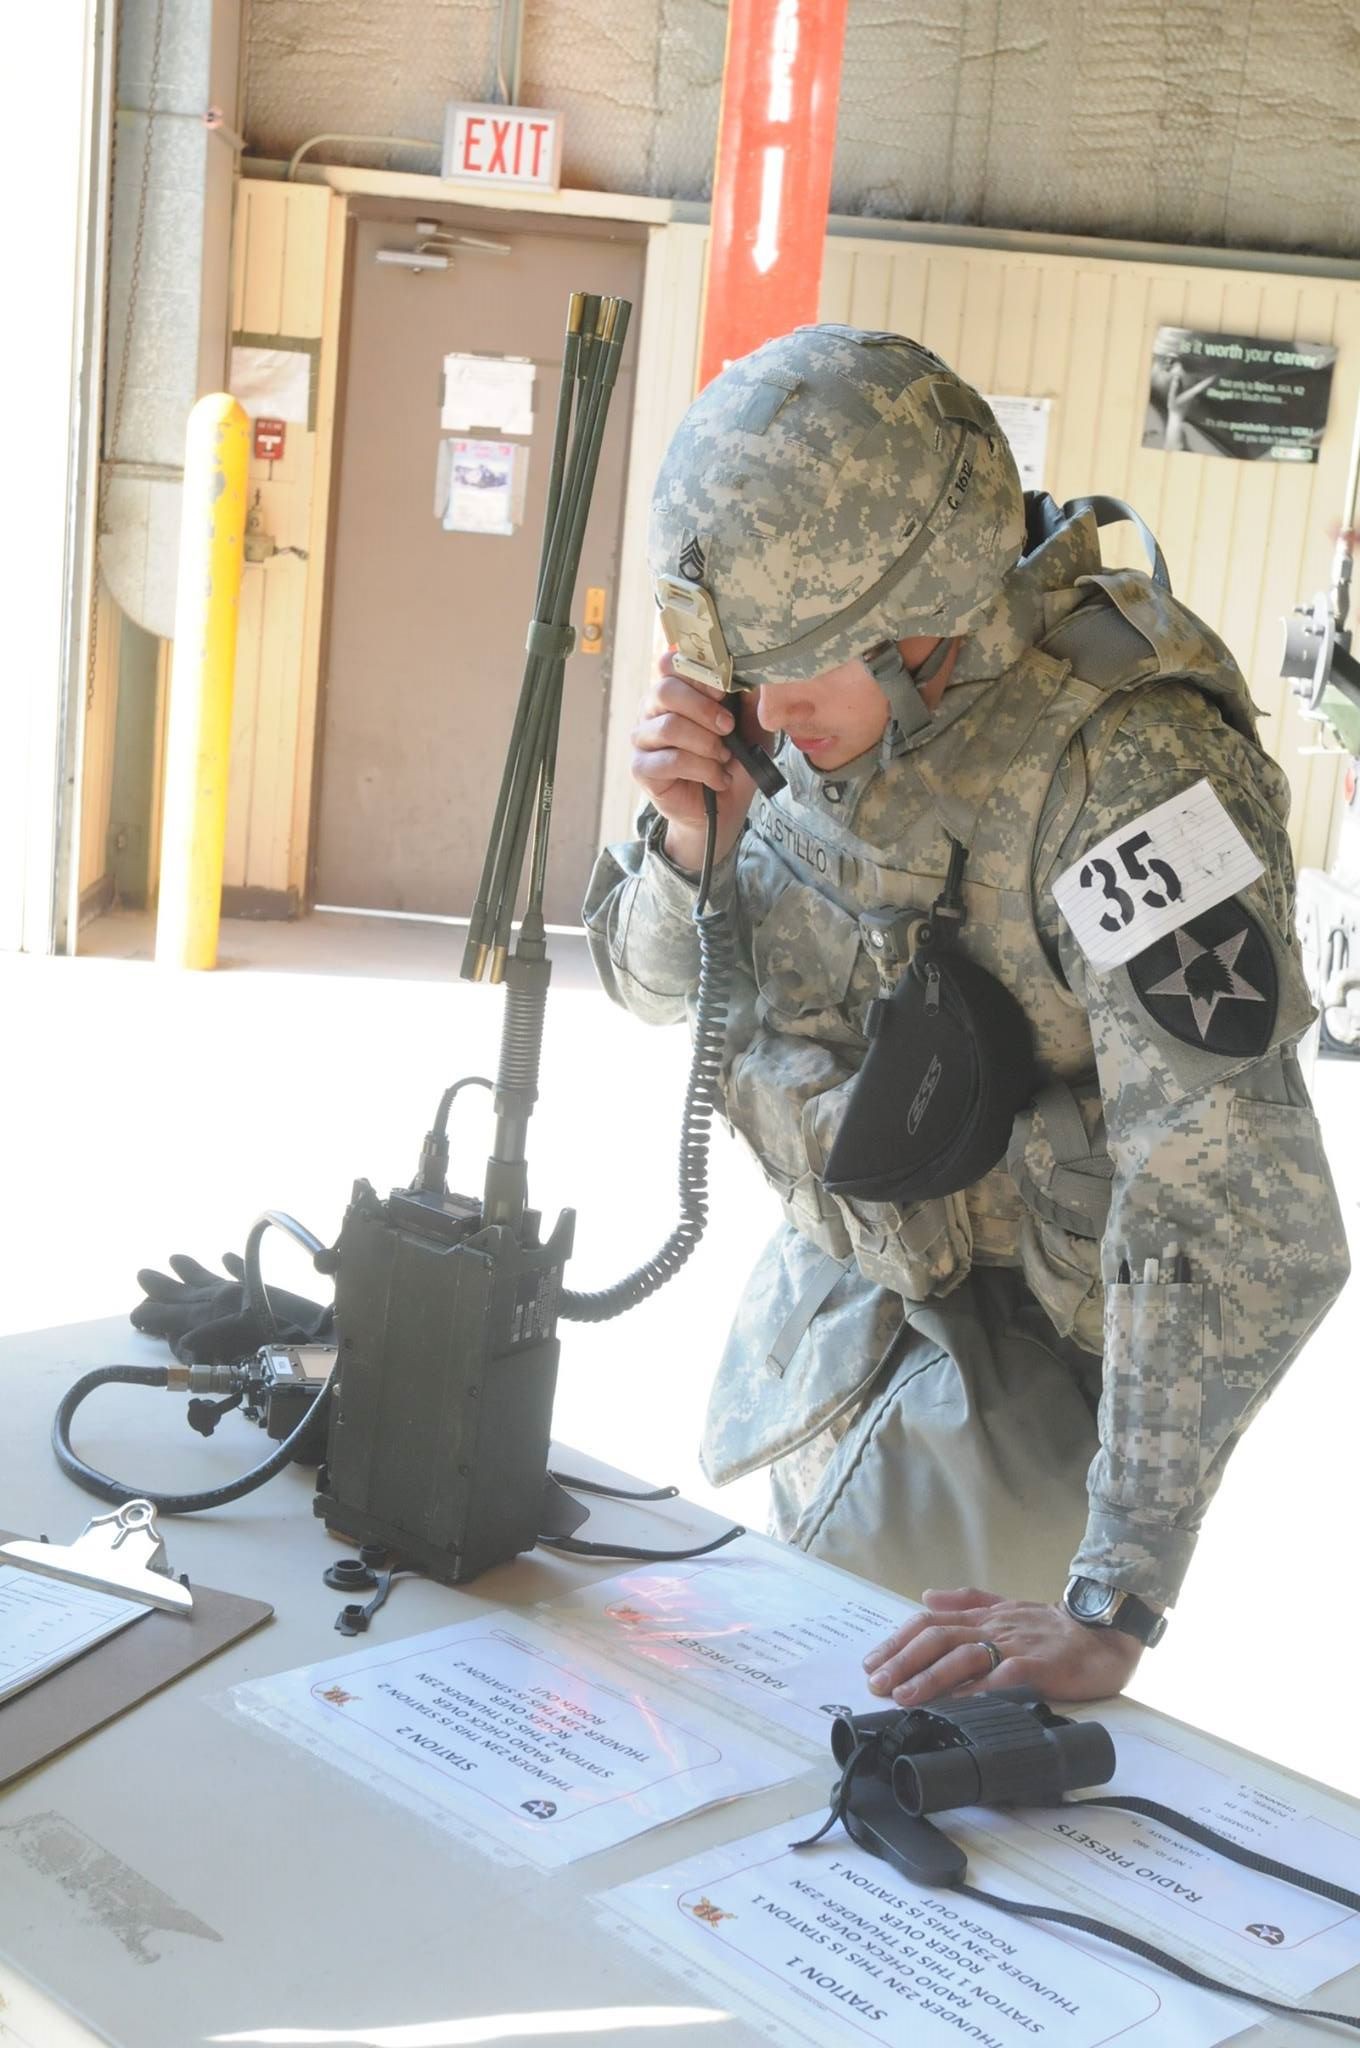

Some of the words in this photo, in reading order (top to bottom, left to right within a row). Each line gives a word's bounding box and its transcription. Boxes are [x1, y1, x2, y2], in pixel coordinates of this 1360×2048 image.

[463, 117, 549, 177] EXIT
[1193, 341, 1202, 354] it
[1205, 343, 1243, 359] worth
[1244, 347, 1272, 363] your
[760, 801, 827, 874] CASTILLO
[1079, 830, 1182, 933] 35
[415, 1672, 445, 1688] 23N
[463, 1667, 517, 1694] STATION
[734, 1663, 788, 1690] RADIO
[386, 1689, 441, 1719] STATION
[441, 1686, 503, 1720] THUNDER
[489, 1694, 526, 1715] OVER
[513, 1692, 530, 1701] IS
[528, 1686, 560, 1702] OUT
[432, 1697, 469, 1718] OVER
[527, 1699, 559, 1716] THIS
[560, 1700, 606, 1726] ROGER
[396, 1726, 414, 1735] 2
[437, 1717, 454, 1726] IS
[450, 1724, 482, 1741] THIS
[466, 1717, 510, 1739] CHECK
[501, 1717, 518, 1726] IS
[514, 1724, 546, 1742] THIS
[524, 1713, 573, 1740] ROGER
[556, 1715, 587, 1731] 23N
[408, 1733, 478, 1771] STATION
[480, 1740, 511, 1756] 23N
[509, 1738, 554, 1764] RADIO
[544, 1741, 559, 1749] 2
[584, 1729, 650, 1763] THUNDER
[508, 1754, 574, 1791] THUNDER
[555, 1747, 614, 1778] STATION
[1053, 1823, 1135, 1869] PRESETS
[829, 1862, 843, 1871] 1
[788, 1879, 825, 1900] 23N
[839, 1869, 908, 1909] STATION
[1135, 1867, 1203, 1903] RADIO
[751, 1894, 766, 1904] 1
[920, 1899, 959, 1919] OUT
[762, 1902, 831, 1945] STATION
[823, 1899, 900, 1948] THUNDER
[905, 1907, 925, 1919] IS
[816, 1912, 862, 1942] OVER
[880, 1912, 925, 1941] OVER
[923, 1917, 961, 1942] THIS
[959, 1919, 1018, 1956] ROGER
[827, 1942, 848, 1955] IS
[861, 1941, 915, 1976] CHECK
[900, 1945, 919, 1958] IS
[925, 1938, 985, 1975] ROGER
[961, 1939, 999, 1962] 23N
[785, 1956, 804, 1967] 1
[845, 1953, 883, 1978] THIS
[917, 1956, 956, 1981] THIS
[800, 1966, 889, 2021] STATION
[883, 1977, 922, 2001] 23N
[915, 1976, 973, 2009] RADIO
[957, 1977, 972, 1987] 1
[997, 1961, 1081, 2016] THUNDER
[970, 1985, 1045, 2034] STATION
[920, 1998, 1004, 2048] THUNDER
